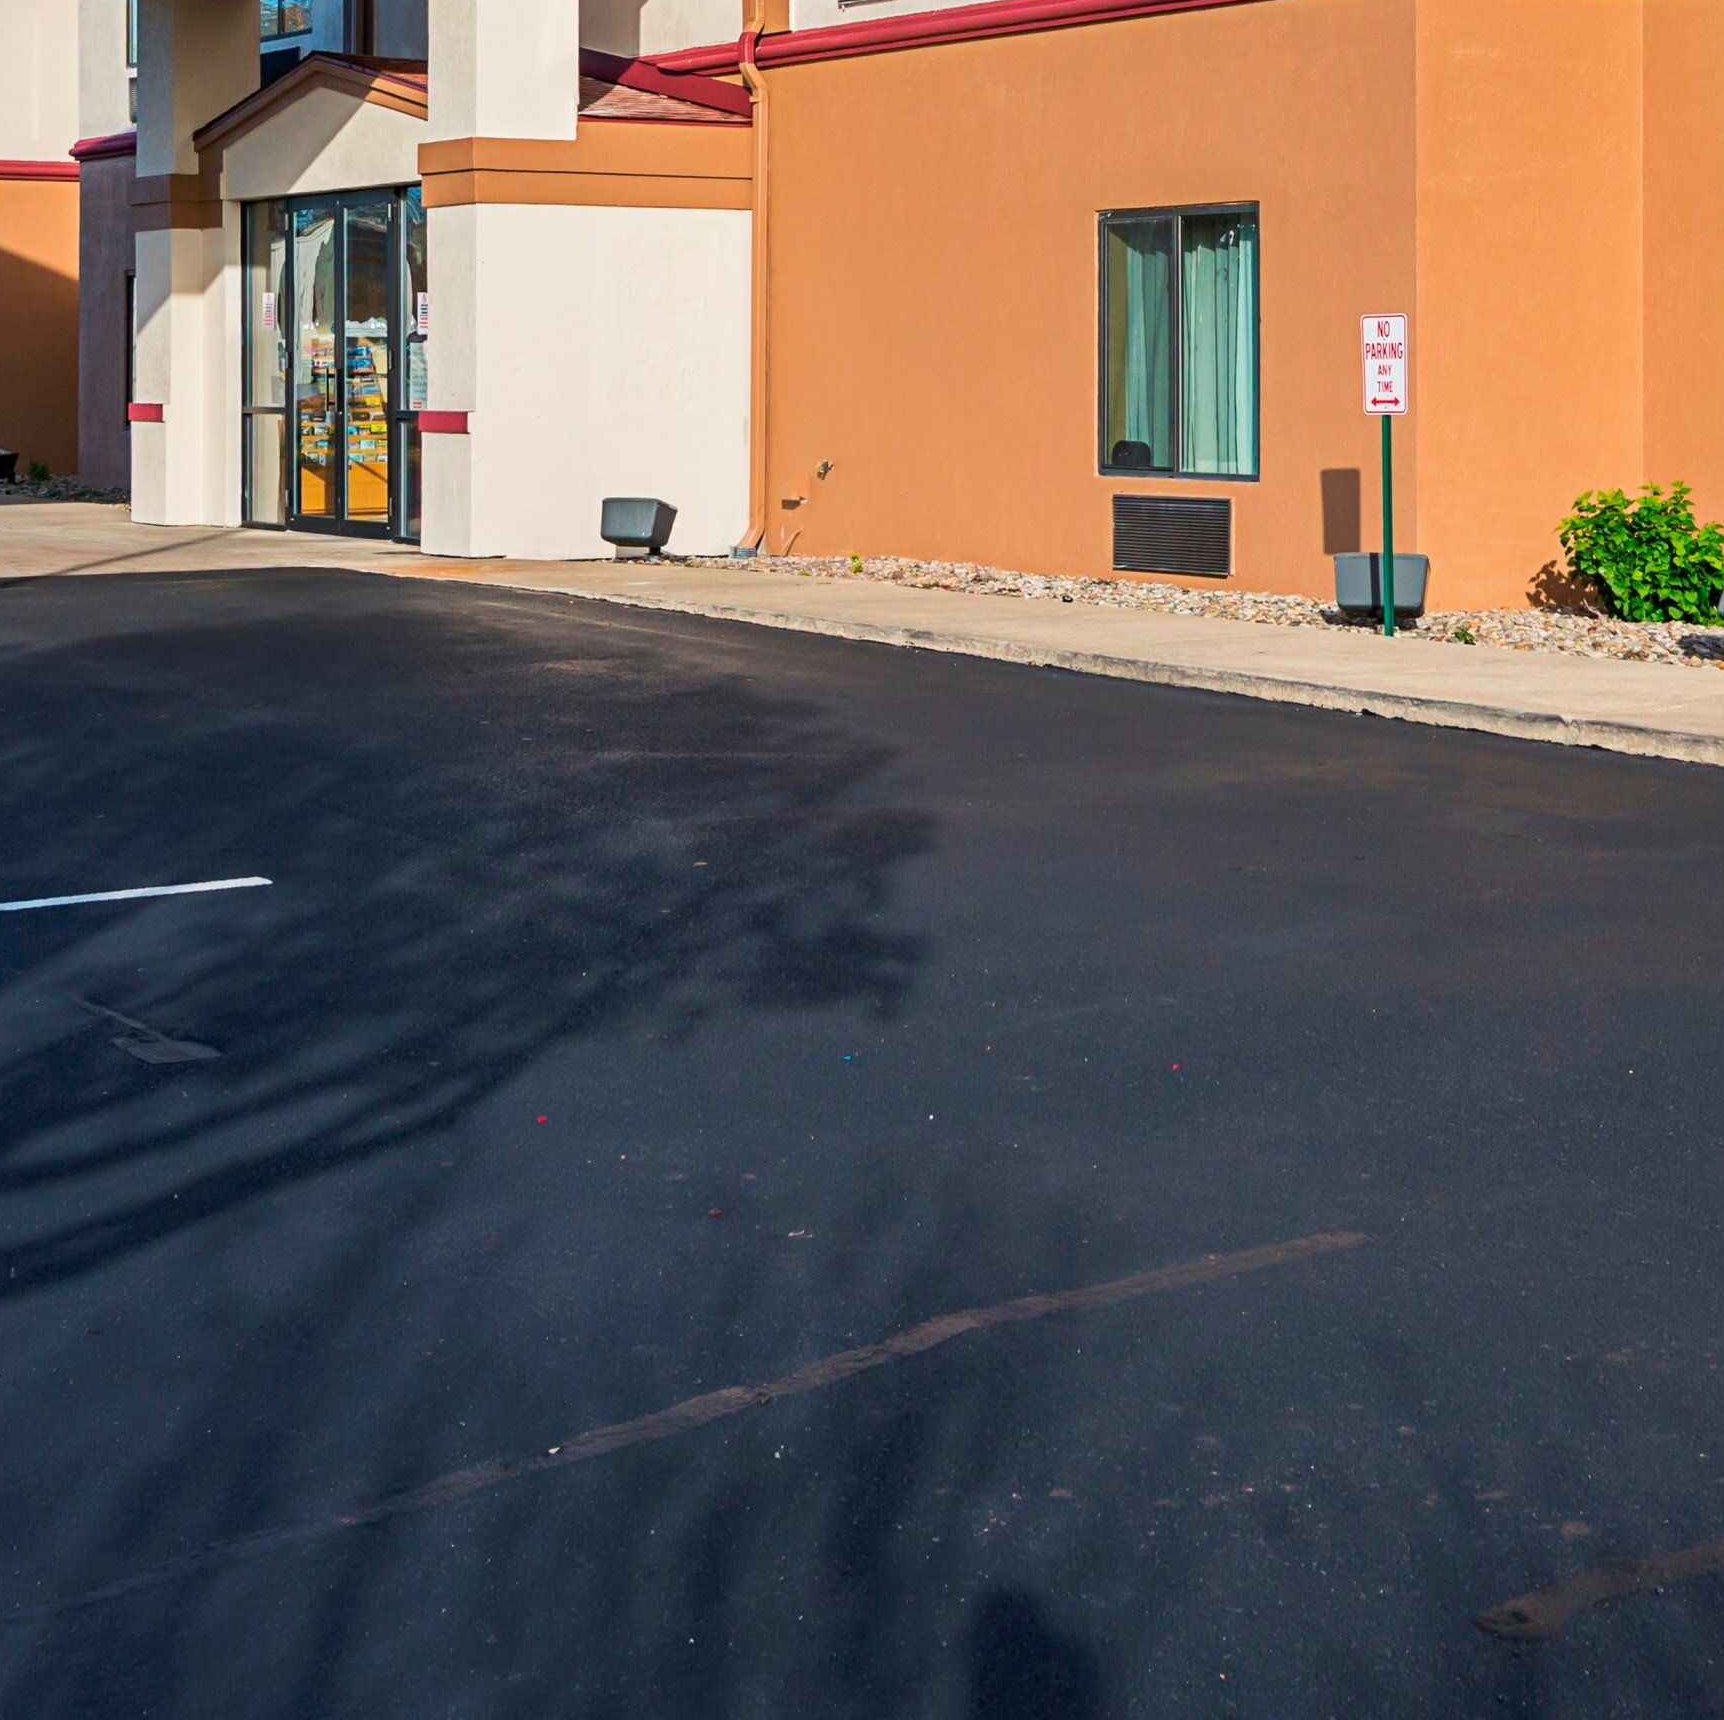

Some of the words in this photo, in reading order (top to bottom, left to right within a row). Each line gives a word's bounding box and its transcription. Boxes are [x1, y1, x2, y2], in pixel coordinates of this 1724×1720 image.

[1377, 321, 1390, 338] NO
[1365, 342, 1403, 359] PARKING
[1377, 364, 1392, 376] ANY
[1377, 380, 1394, 393] TIME
